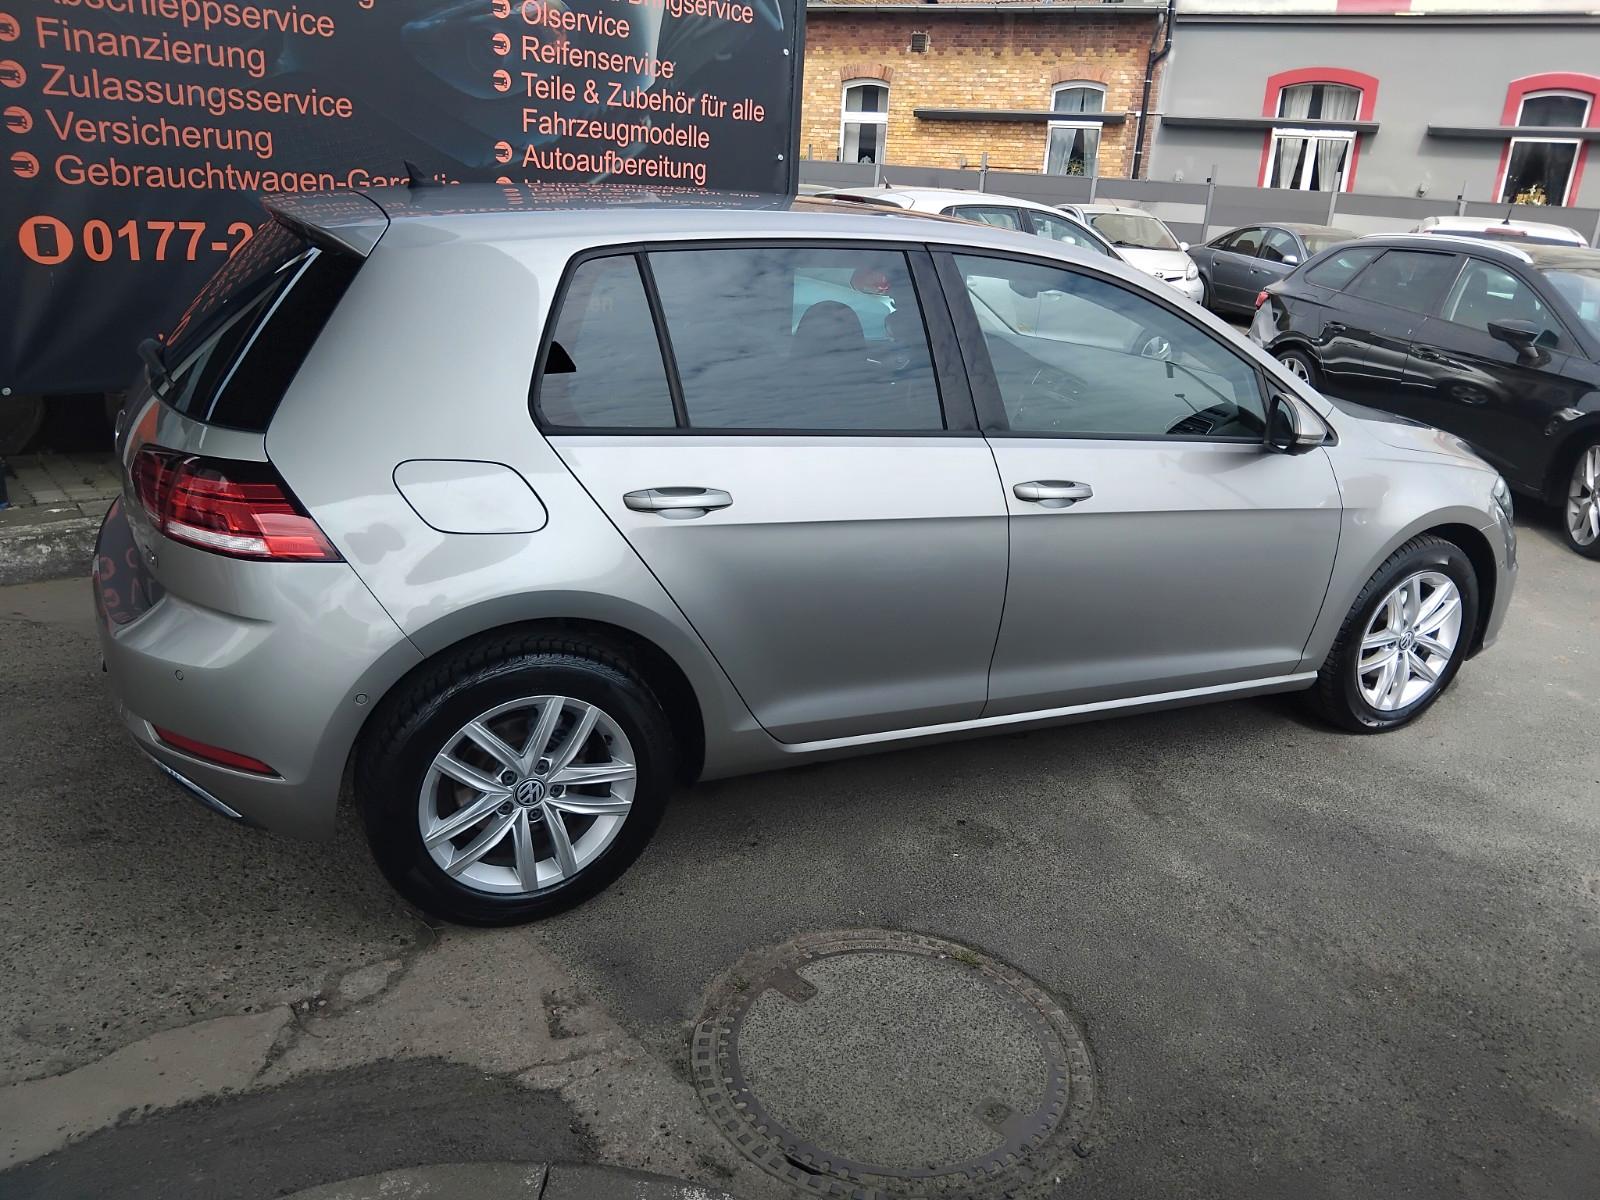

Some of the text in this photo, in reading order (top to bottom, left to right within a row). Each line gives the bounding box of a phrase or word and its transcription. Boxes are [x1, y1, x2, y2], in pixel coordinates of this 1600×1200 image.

[36, 16, 266, 78] Finanzierung
[521, 36, 676, 79] Reifenservice
[41, 63, 353, 118] Zulassungsservice
[521, 72, 765, 122] Teile & Zubehör für alle
[45, 109, 273, 159] Versicherung
[522, 107, 710, 149] Fahrzeugmodelle
[55, 154, 461, 193] Gebrauchtwagen-Gar
[522, 143, 707, 186] Autoaufbereitung
[83, 219, 265, 262] 0177-2
